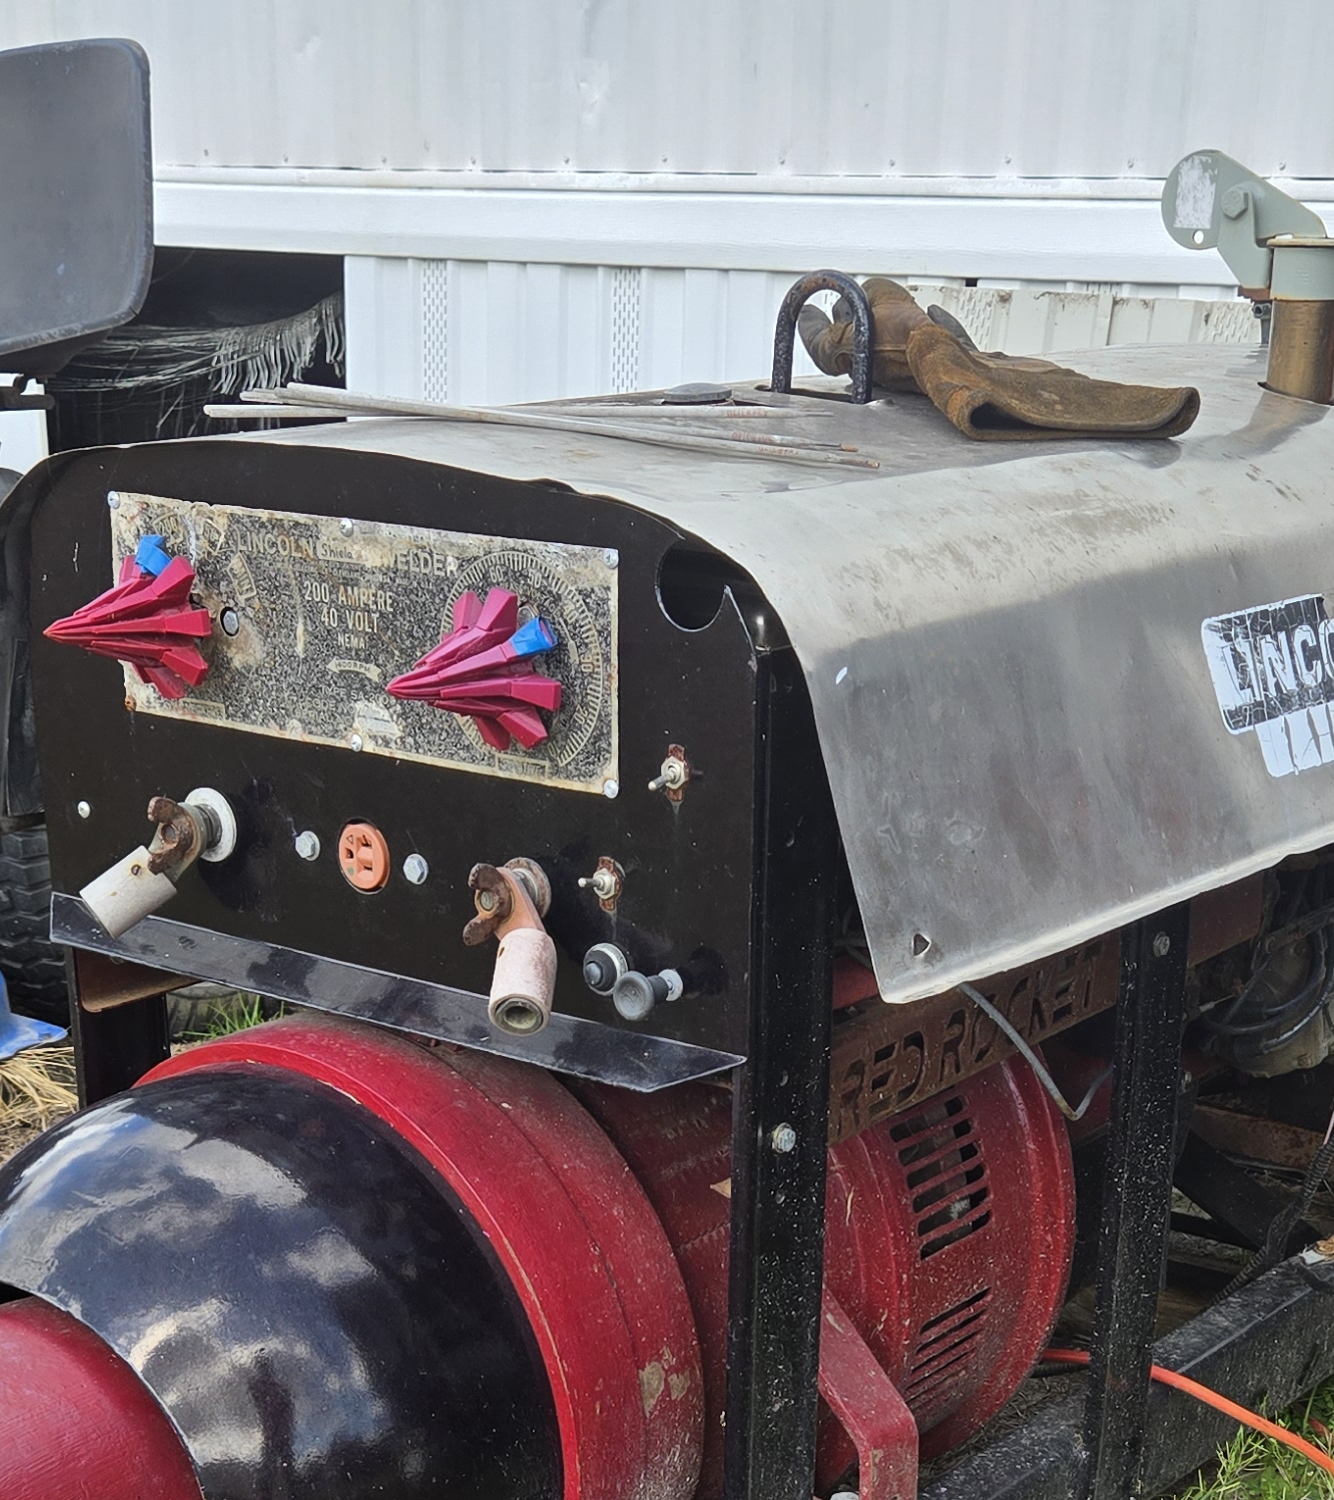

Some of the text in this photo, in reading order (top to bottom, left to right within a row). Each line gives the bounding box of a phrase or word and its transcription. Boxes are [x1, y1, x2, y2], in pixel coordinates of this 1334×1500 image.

[235, 527, 314, 560] LINCOLN
[489, 564, 505, 583] 60
[527, 567, 543, 589] 50
[303, 580, 395, 613] 200 AMPERE
[320, 609, 380, 635] 40 VOLT
[337, 632, 366, 651] NEMA
[835, 939, 1105, 1137] RED ROCKET
